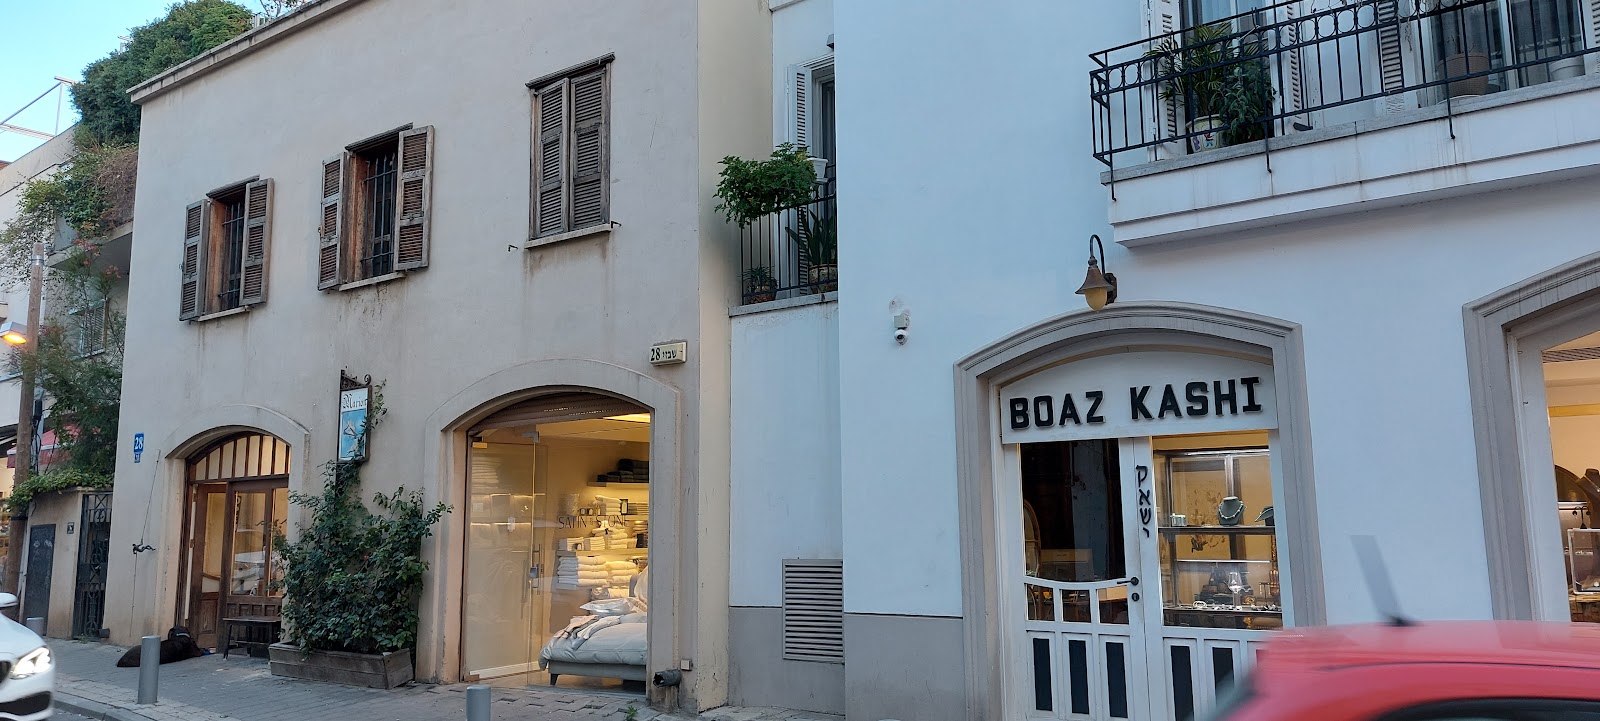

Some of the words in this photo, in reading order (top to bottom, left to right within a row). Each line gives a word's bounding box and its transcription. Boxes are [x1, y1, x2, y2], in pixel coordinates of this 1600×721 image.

[650, 347, 661, 361] 28
[1010, 391, 1104, 429] BOAZ
[1130, 376, 1262, 420] KASHI
[135, 437, 144, 450] 28
[1135, 464, 1152, 538] קאשי
[559, 515, 587, 529] SATIN
[596, 513, 629, 528] STONE
